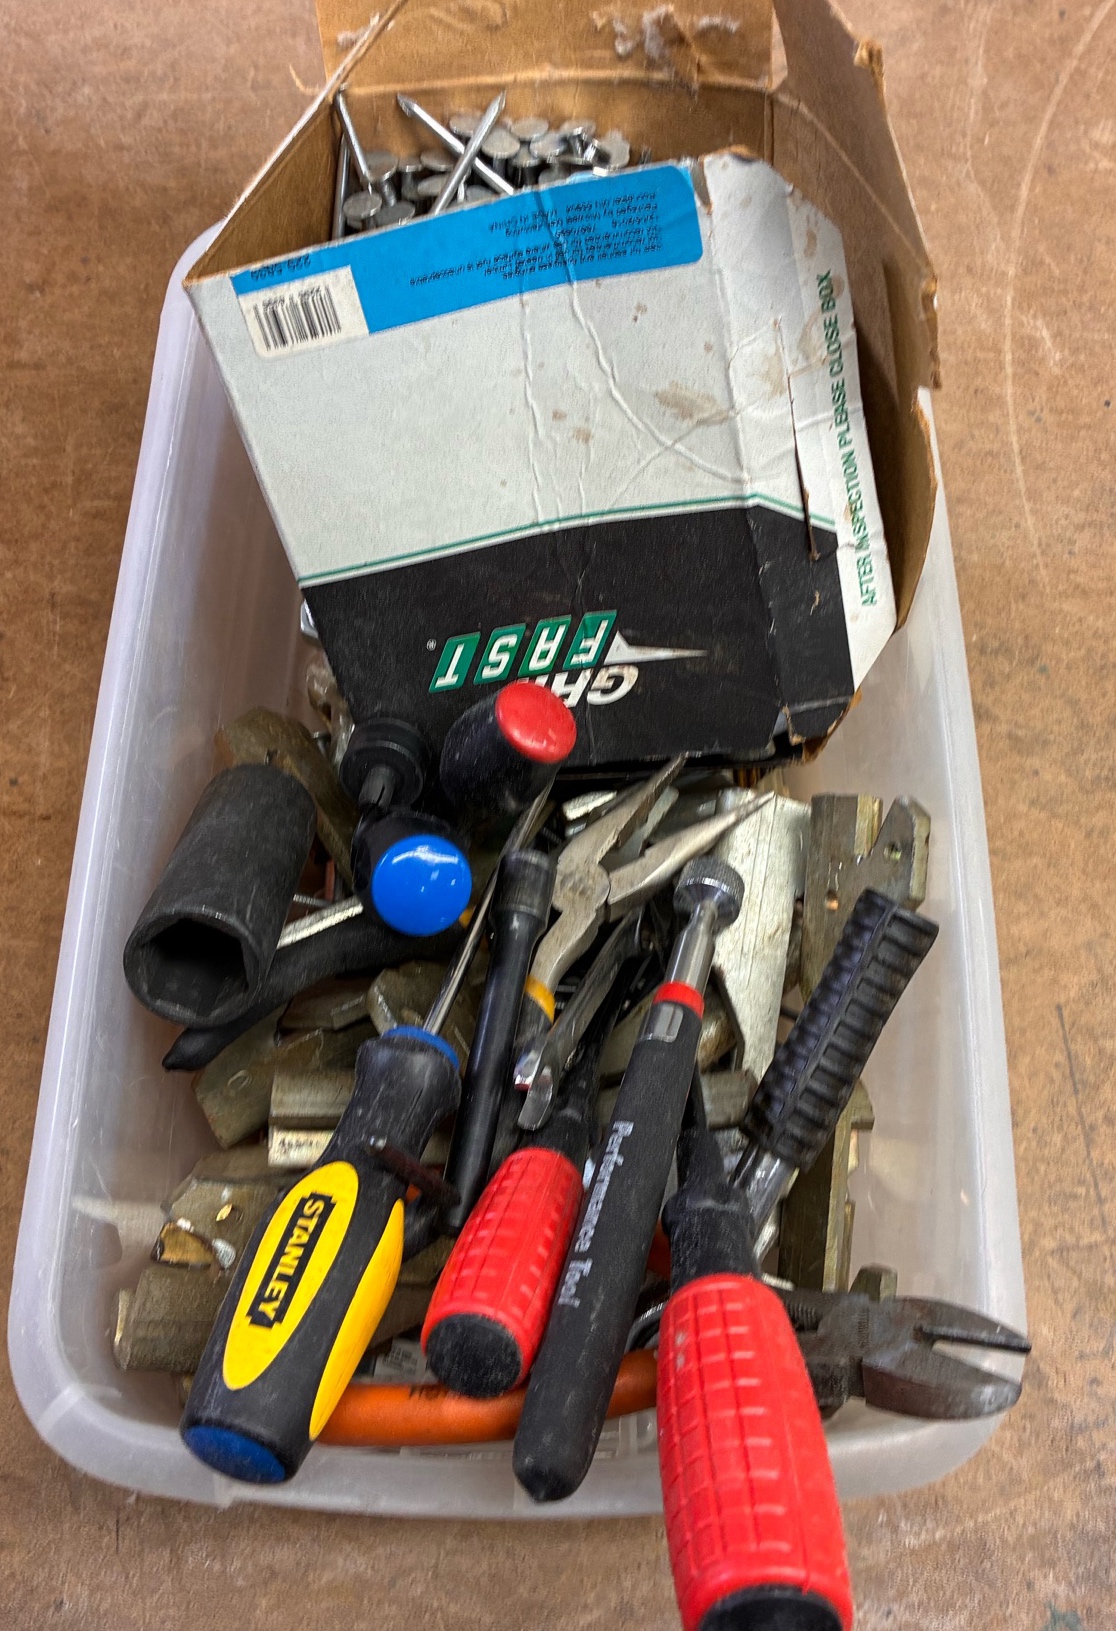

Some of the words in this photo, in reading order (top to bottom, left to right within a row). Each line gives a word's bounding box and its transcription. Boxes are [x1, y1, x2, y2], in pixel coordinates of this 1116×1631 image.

[816, 268, 836, 314] BOX
[823, 313, 844, 377] CLOSE
[831, 378, 853, 450] PLEASE
[840, 450, 871, 553] INSPECTION
[857, 552, 878, 607] AFTER
[433, 618, 610, 690] FAST
[574, 1120, 635, 1253] Performance
[258, 1199, 326, 1321] STANLEY
[557, 1257, 593, 1309] Tool
